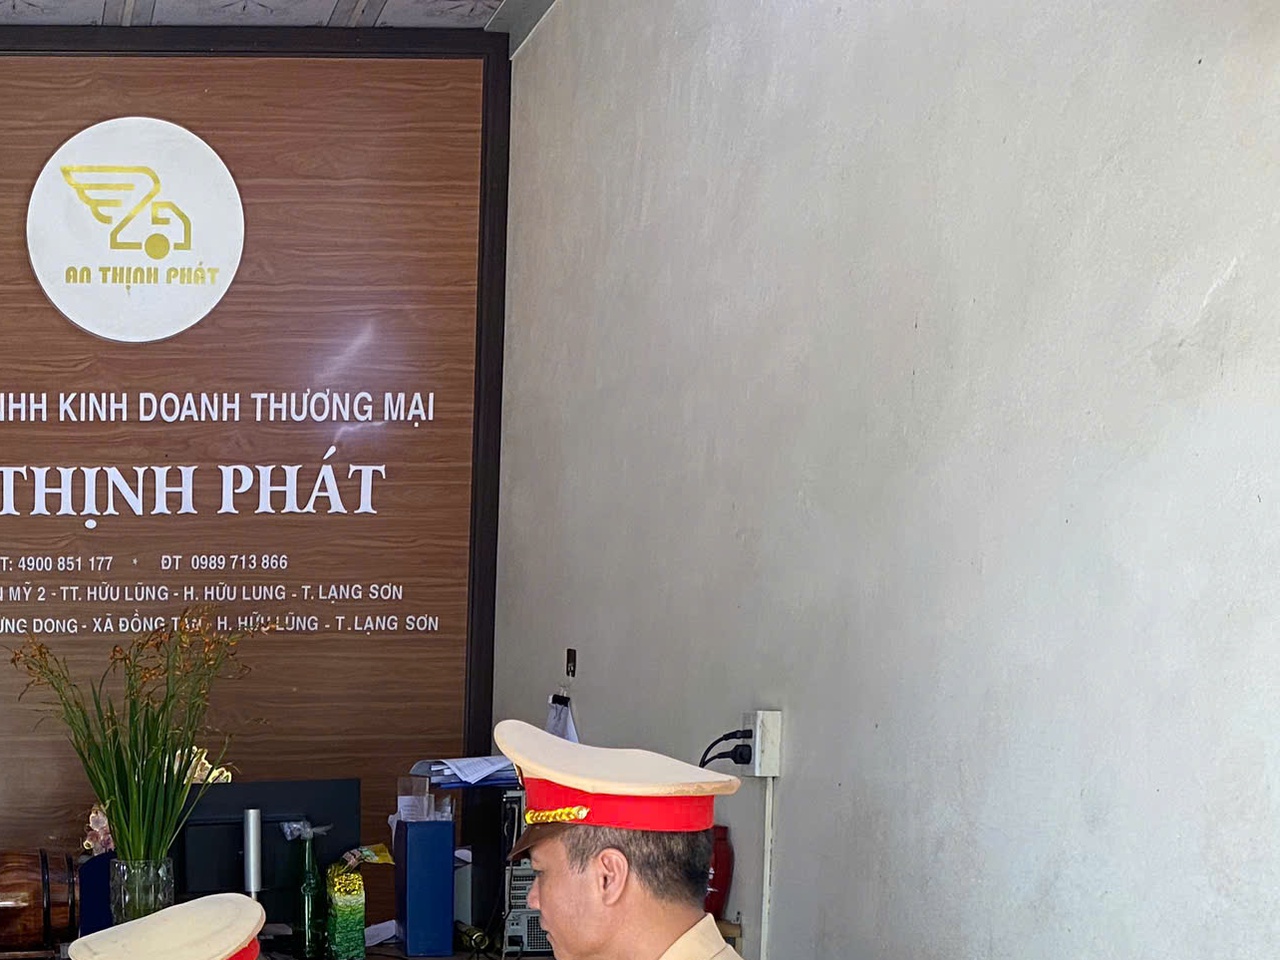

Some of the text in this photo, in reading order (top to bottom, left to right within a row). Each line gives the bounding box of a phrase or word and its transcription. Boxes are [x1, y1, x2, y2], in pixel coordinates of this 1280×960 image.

[65, 261, 219, 293] AN THỊNH PHÁT
[58, 392, 128, 422] KINH
[139, 392, 240, 422] DOANH
[251, 388, 373, 422] THƯƠNG
[383, 391, 435, 428] MẠI
[216, 446, 387, 515] PHÁT
[18, 556, 53, 572] 4900
[57, 556, 82, 572] 851
[88, 556, 113, 571] 177
[161, 555, 182, 570] ĐT
[191, 555, 226, 570] 0989
[230, 555, 257, 570] 713
[261, 555, 288, 570] 866
[9, 581, 33, 602] MỸ
[37, 586, 46, 602] 2
[60, 586, 82, 601] TT.
[87, 581, 120, 602] HỮU
[125, 581, 169, 602] LŨNG
[184, 585, 199, 601] H.
[205, 581, 237, 601] HỮU
[243, 585, 286, 601] LUNG
[302, 585, 314, 600] T.
[319, 584, 363, 604] LẠNG
[369, 582, 403, 600] SƠN
[32, 618, 78, 634] DONG
[92, 613, 114, 633] XÃ
[119, 609, 166, 633] ĐỒNG
[217, 616, 232, 631] H.
[275, 611, 319, 631] LŨNG
[405, 613, 439, 631] SƠN
